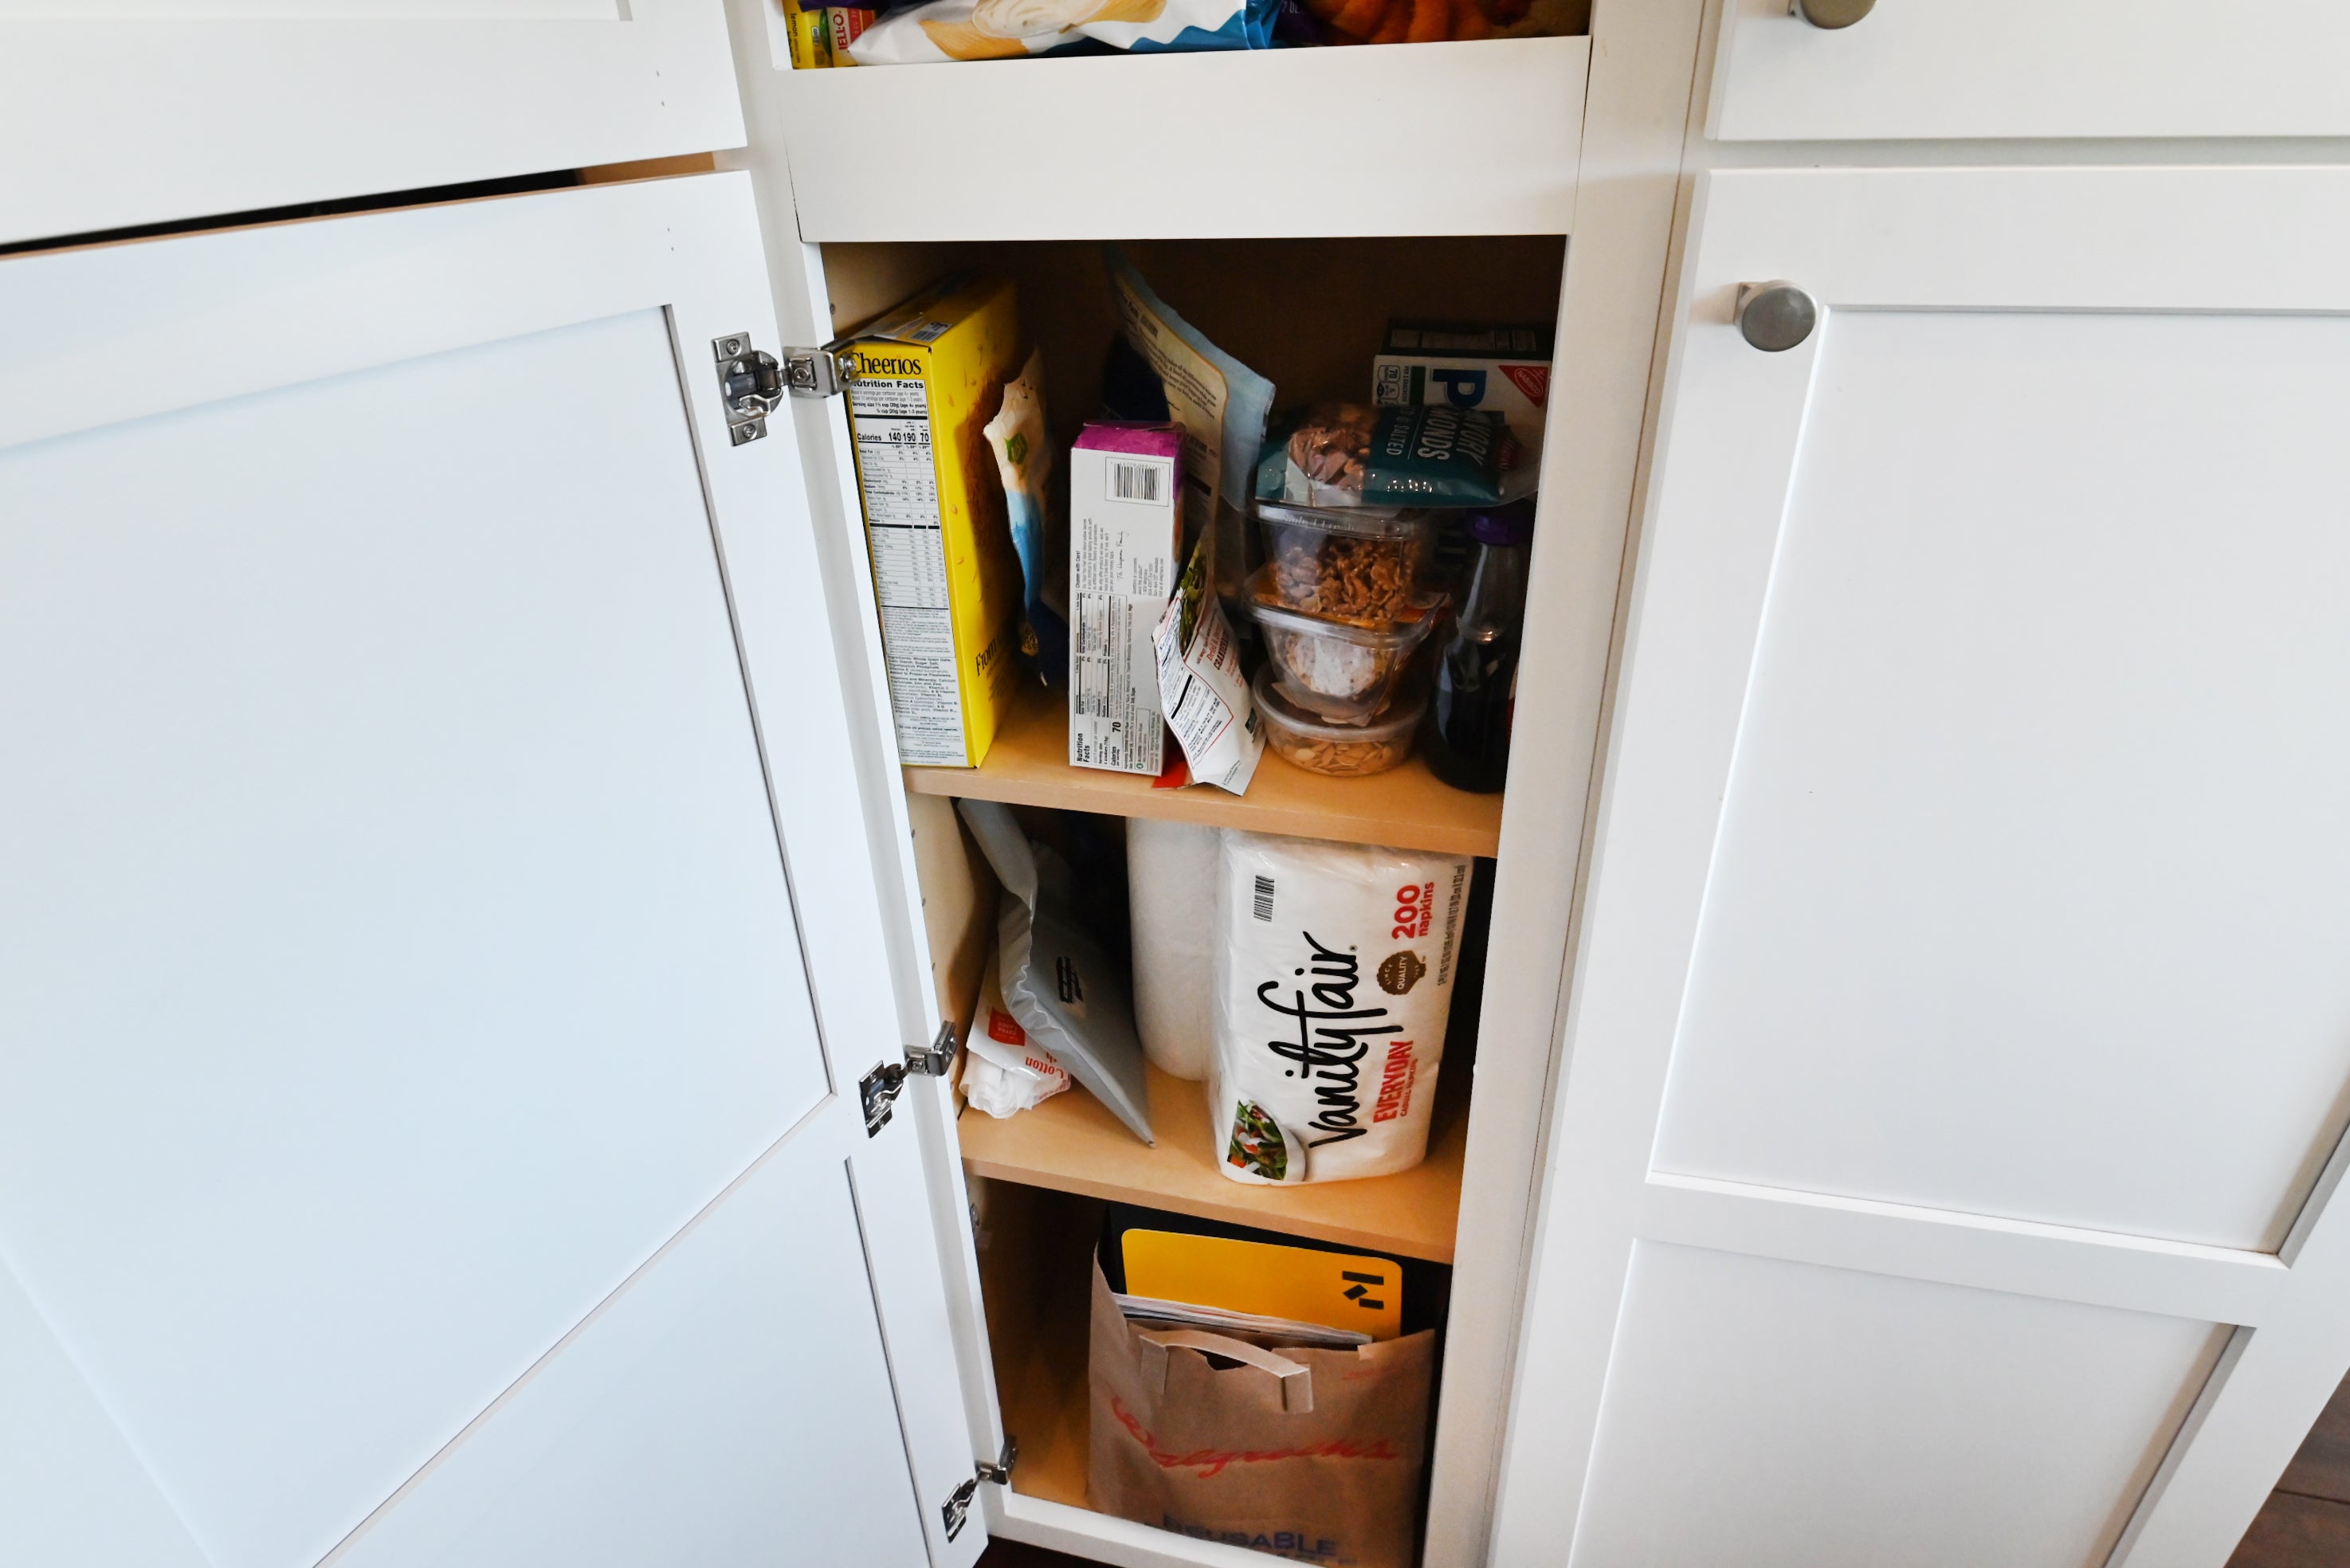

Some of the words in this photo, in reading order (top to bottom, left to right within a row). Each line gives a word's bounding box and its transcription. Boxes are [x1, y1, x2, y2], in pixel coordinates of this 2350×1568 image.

[1388, 368, 1399, 379] 70
[1517, 370, 1541, 394] NABISCO
[889, 433, 901, 441] 140
[903, 433, 916, 441] 190
[920, 433, 929, 441] 70
[1386, 424, 1410, 456] SALTED
[1417, 406, 1459, 461] MONDS
[975, 638, 996, 676] From
[1112, 721, 1121, 733] 70
[1391, 884, 1420, 940] 200
[1417, 881, 1434, 938] napkins
[1396, 955, 1408, 990] QUALITY
[1025, 1056, 1065, 1080] Cotton
[1372, 1039, 1414, 1123] EVERYDAY
